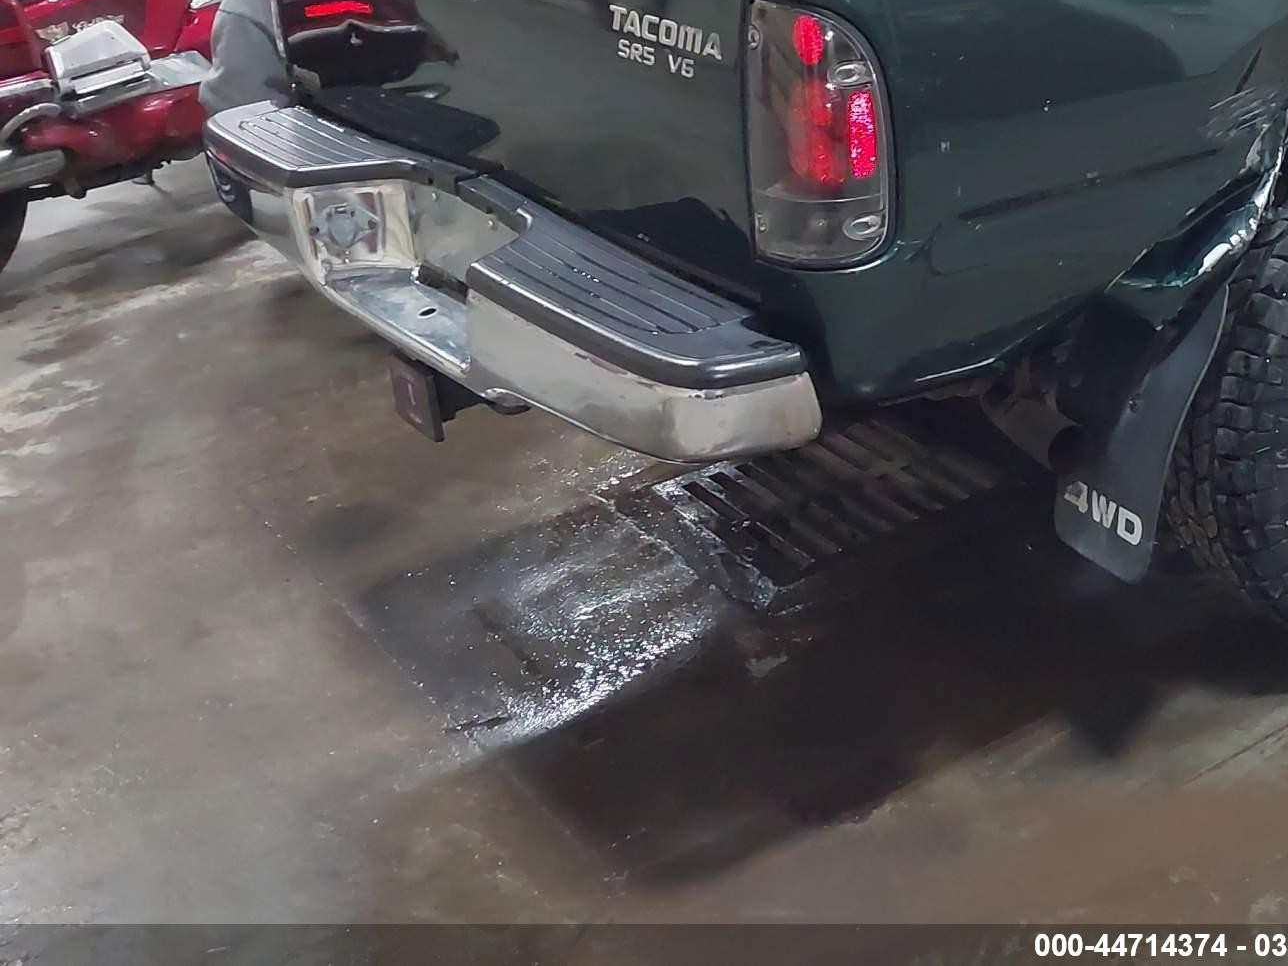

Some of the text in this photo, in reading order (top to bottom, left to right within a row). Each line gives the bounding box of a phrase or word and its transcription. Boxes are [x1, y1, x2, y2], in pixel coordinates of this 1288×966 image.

[608, 4, 722, 60] TACOMA
[617, 39, 695, 78] SR5 V6
[1063, 480, 1143, 546] 4WD
